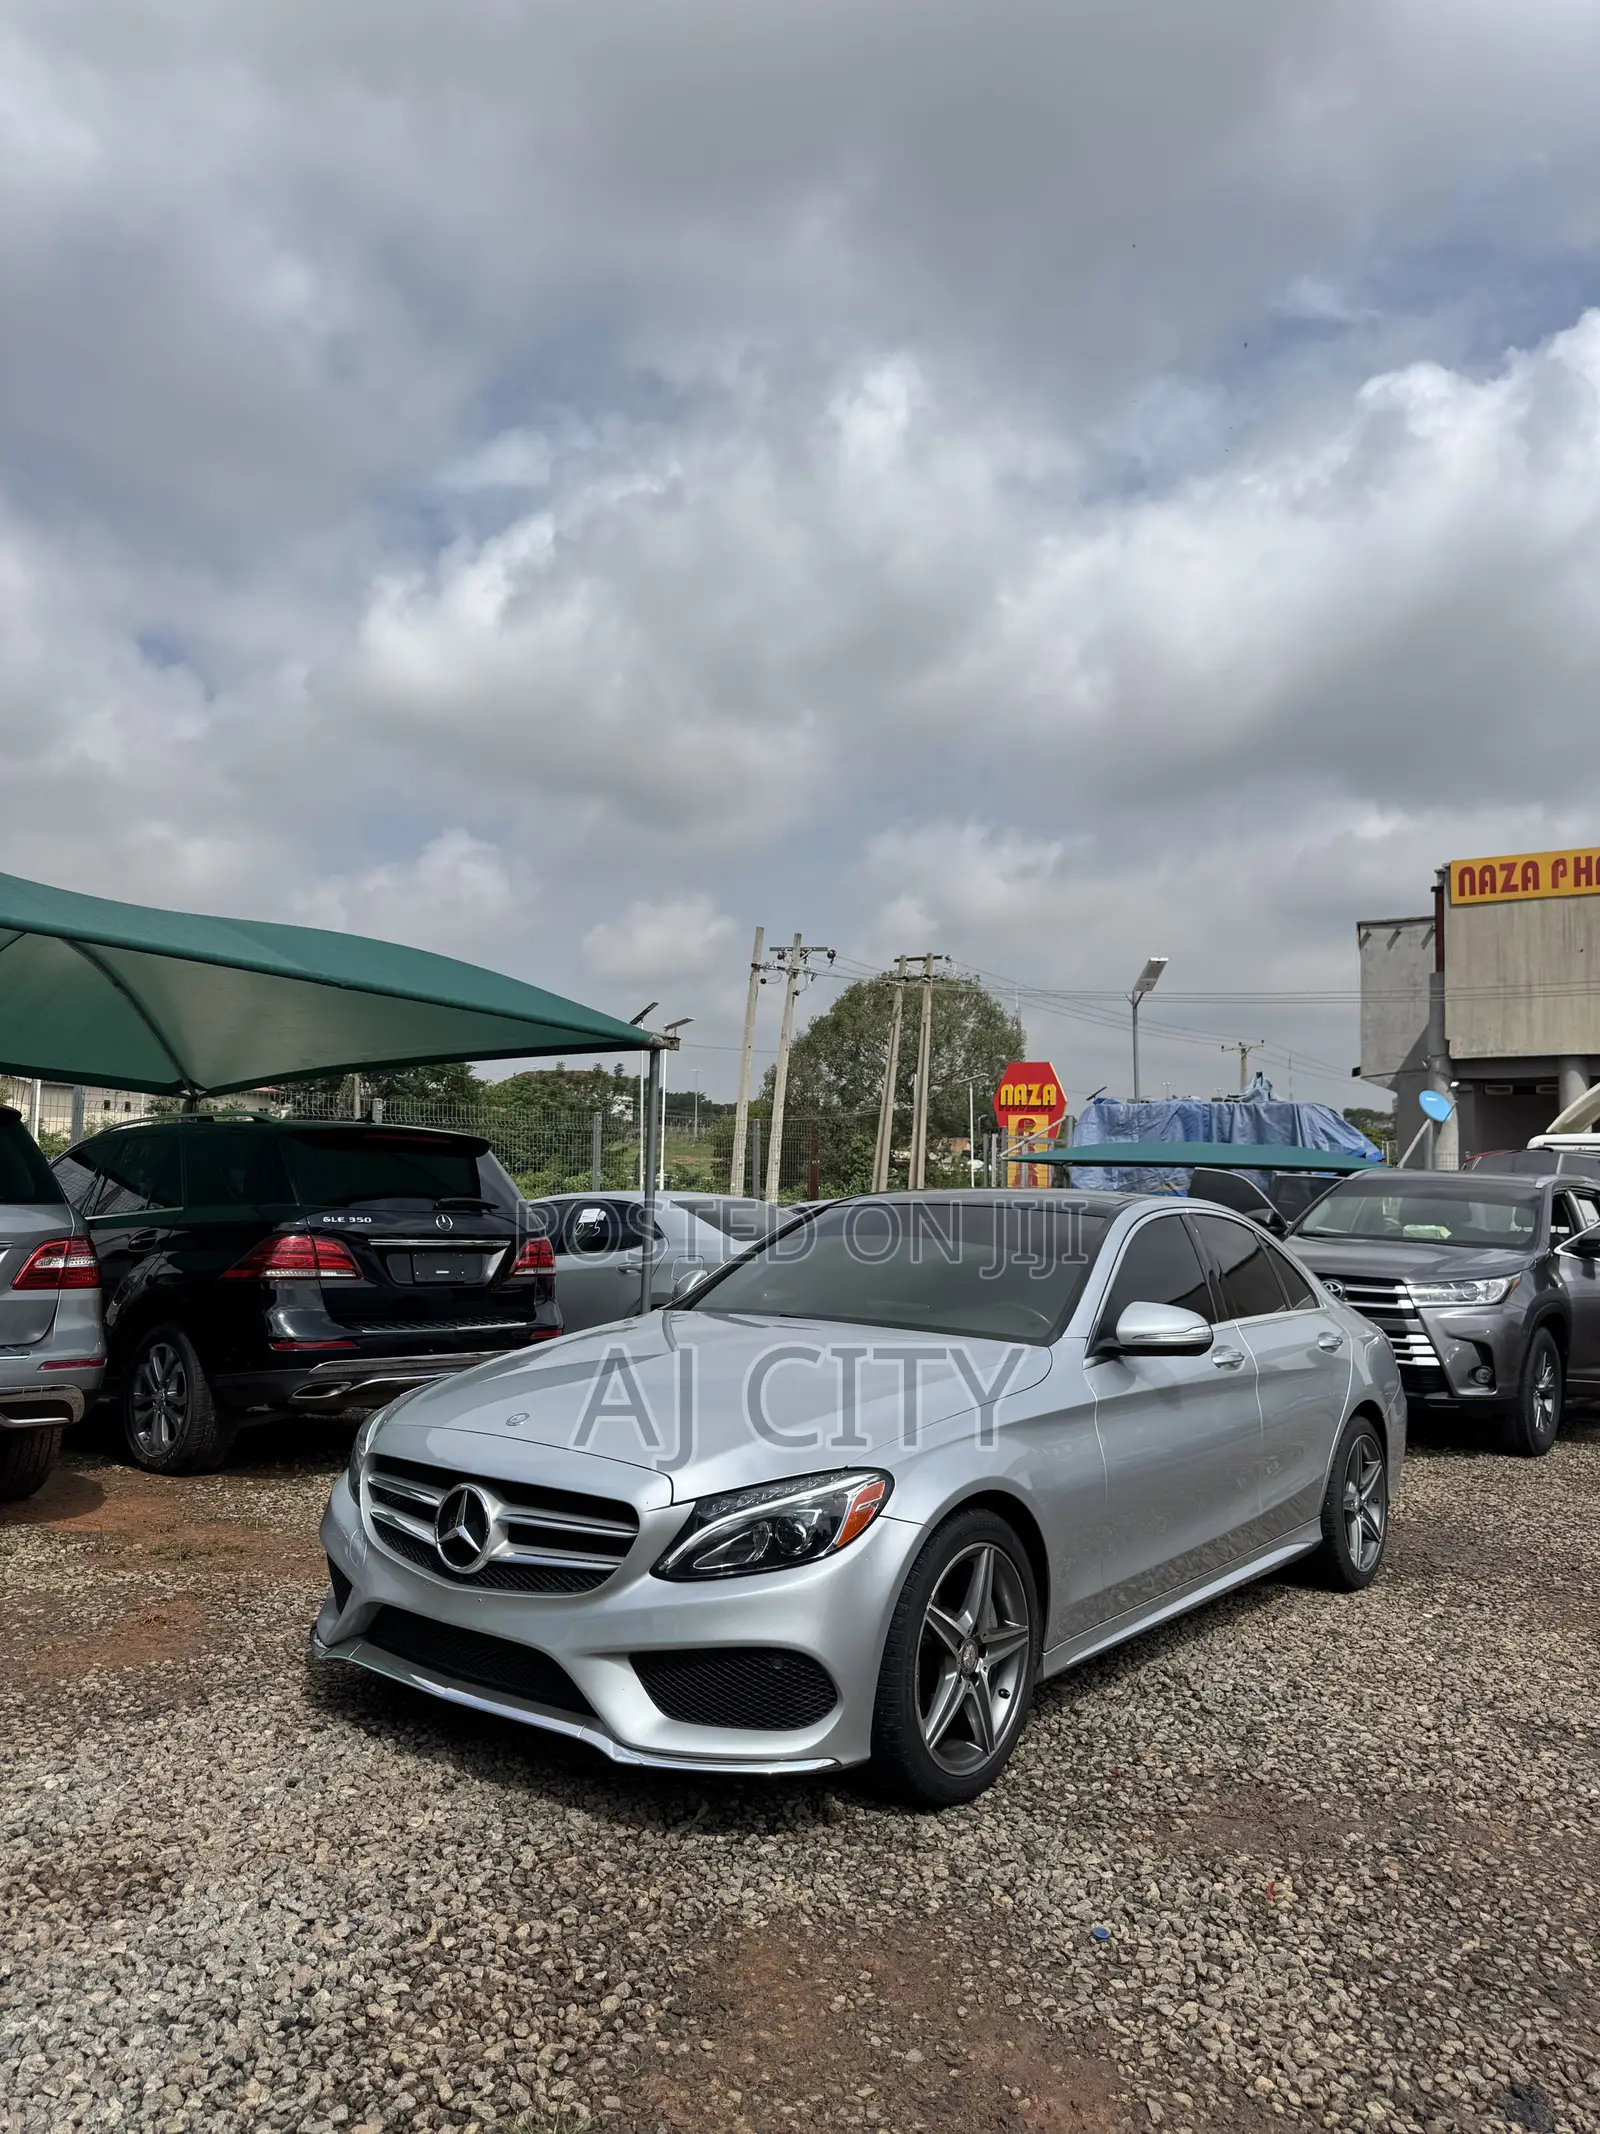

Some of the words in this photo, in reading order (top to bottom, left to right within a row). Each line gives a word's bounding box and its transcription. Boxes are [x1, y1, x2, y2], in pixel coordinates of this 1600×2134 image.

[1458, 860, 1540, 897] NAZA
[1551, 855, 1600, 889] PH
[1000, 1083, 1056, 1106] NAZA
